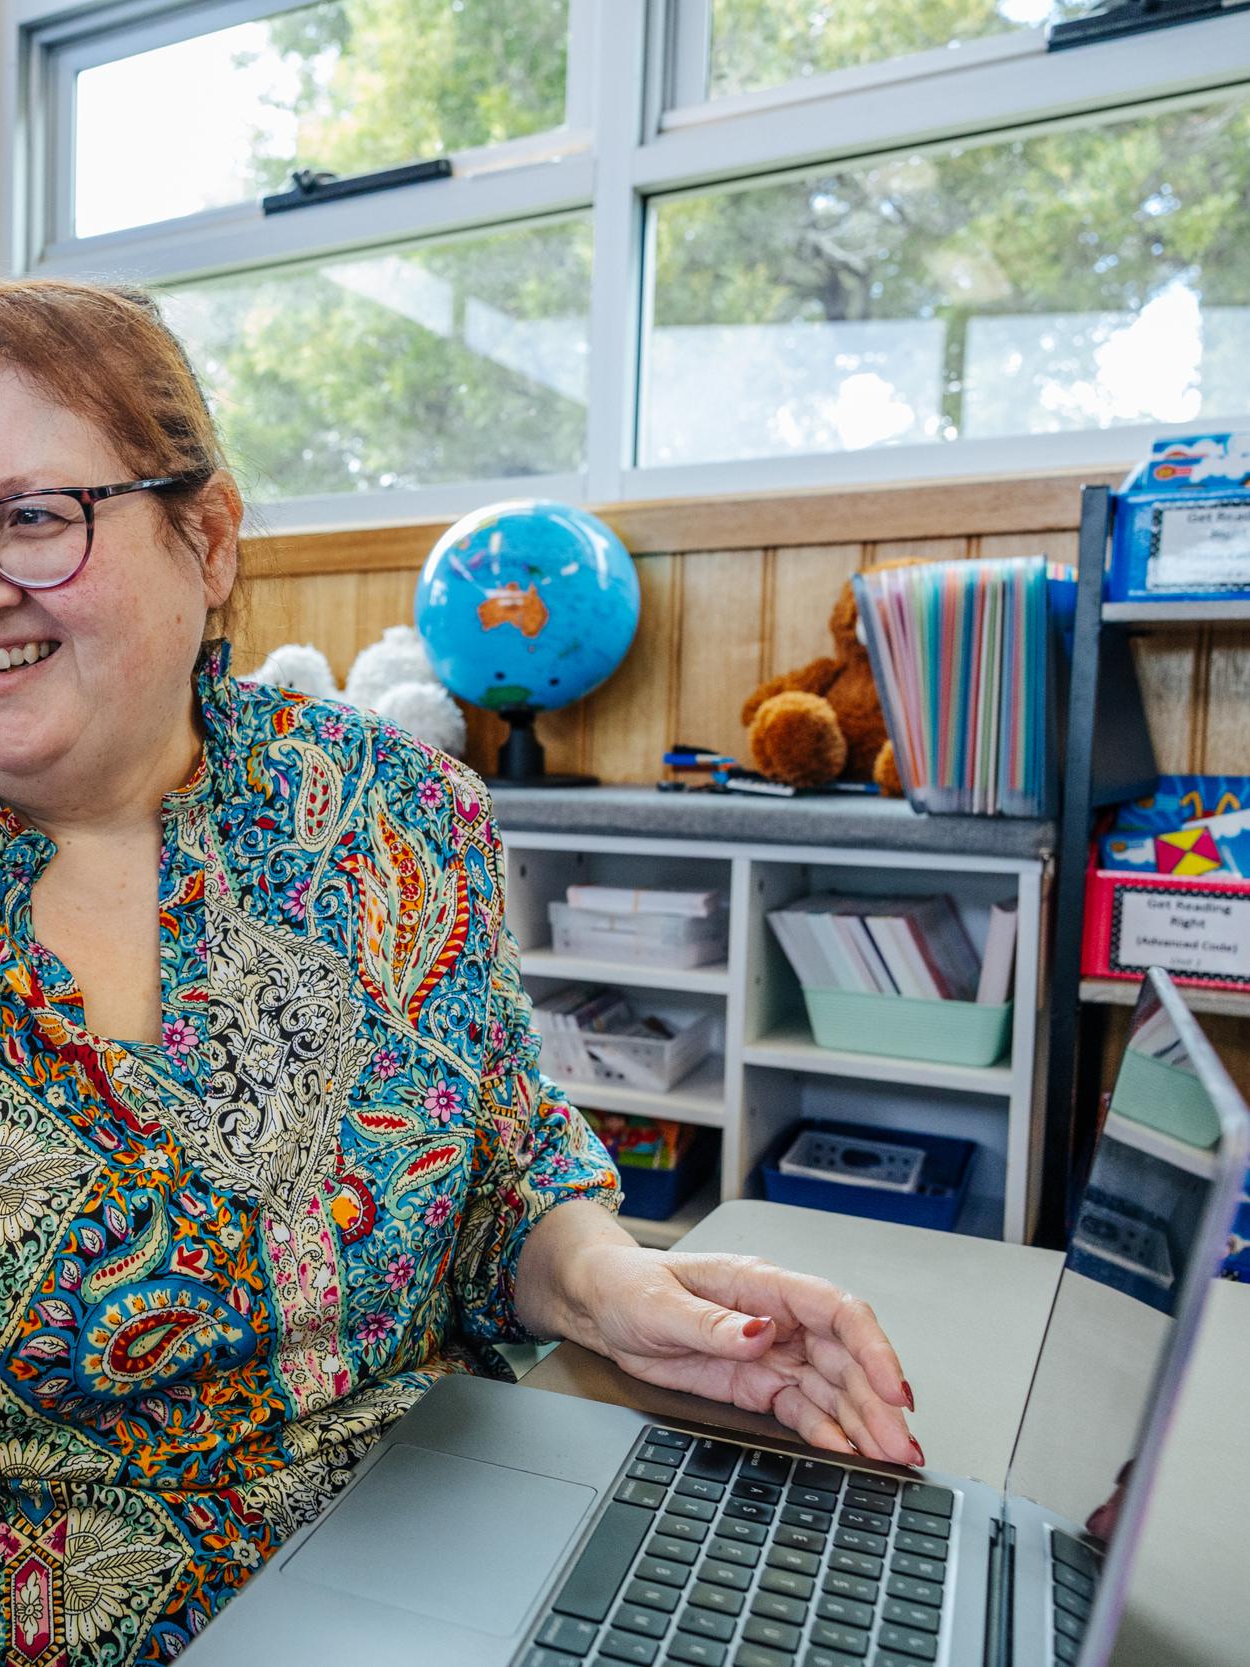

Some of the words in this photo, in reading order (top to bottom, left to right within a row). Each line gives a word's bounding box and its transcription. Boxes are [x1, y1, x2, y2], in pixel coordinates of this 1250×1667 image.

[1216, 511, 1250, 522] Read
[1147, 897, 1171, 910] Get
[1176, 900, 1232, 916] Reading
[1170, 915, 1206, 930] Right
[693, 1484, 708, 1492] Z
[804, 1494, 820, 1502] Q
[742, 1506, 757, 1514] S
[799, 1513, 814, 1522] W
[848, 1514, 864, 1522] 2
[843, 1535, 860, 1543] 3
